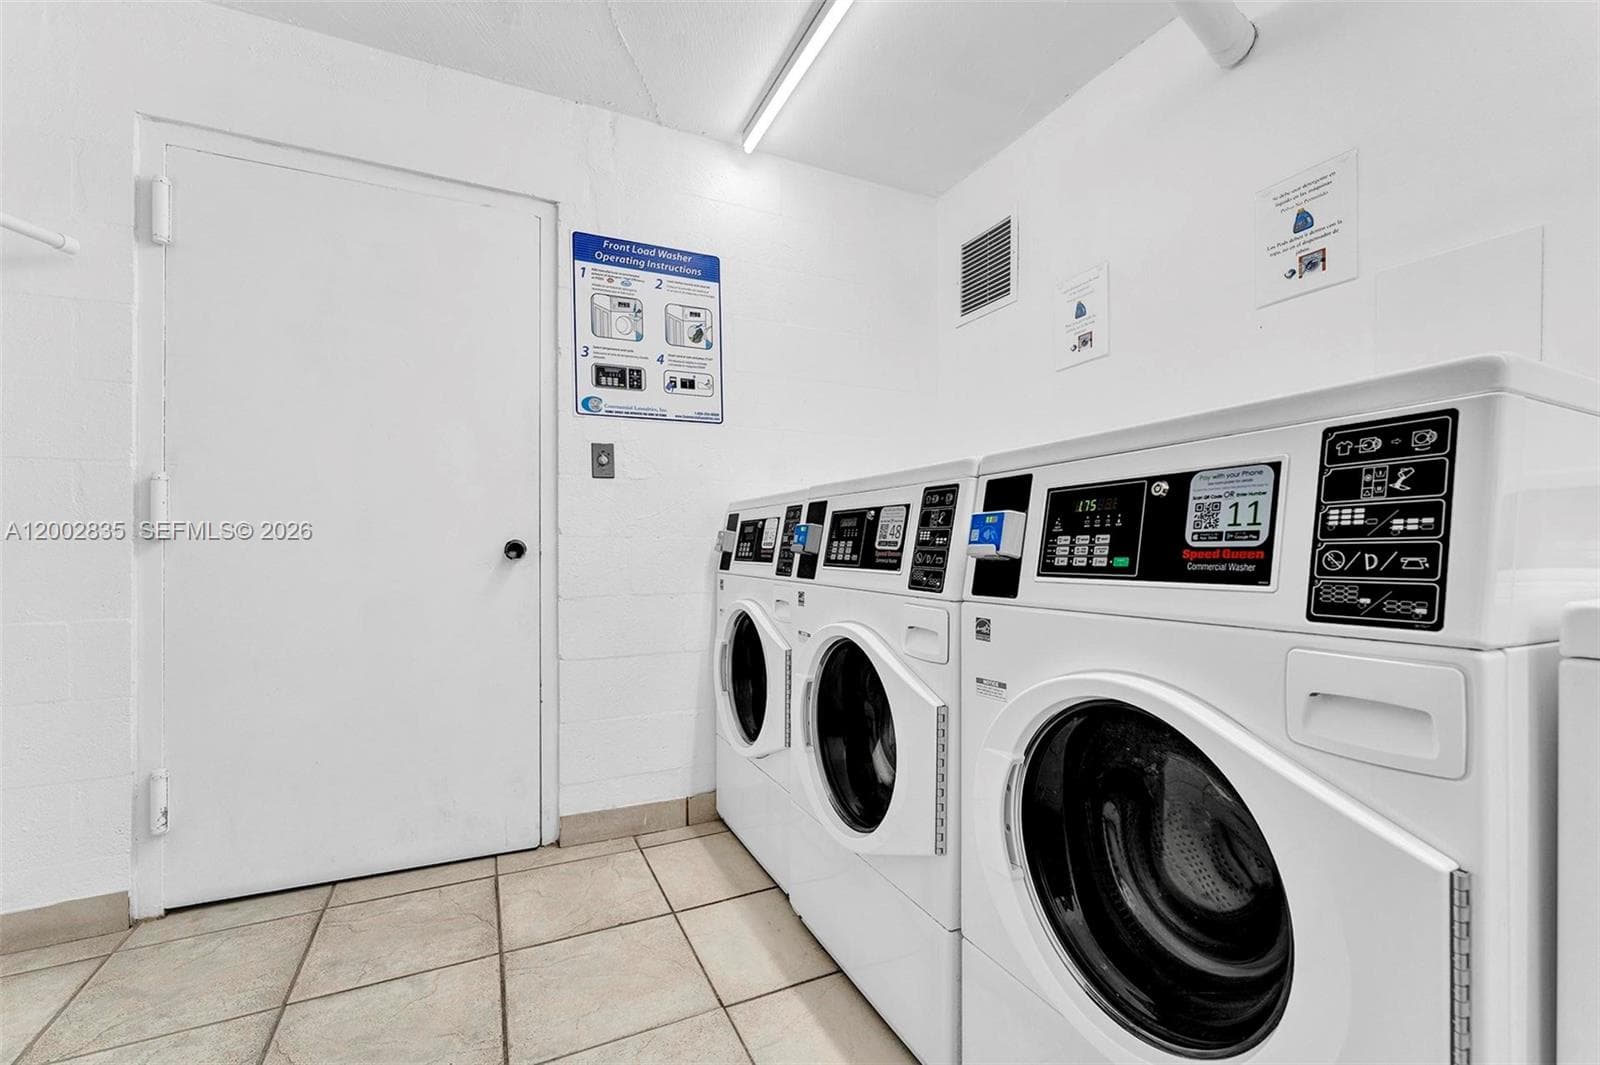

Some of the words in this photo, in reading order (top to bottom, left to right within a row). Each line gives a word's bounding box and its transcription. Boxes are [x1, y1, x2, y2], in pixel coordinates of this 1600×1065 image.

[603, 240, 630, 252] Front
[632, 245, 656, 256] Load
[658, 250, 692, 262] Washer
[594, 251, 645, 268] Operating
[647, 260, 702, 276] Instructions
[580, 267, 586, 278] 1
[655, 279, 663, 290] 2
[581, 346, 589, 357] 3
[656, 354, 664, 364] 4
[1224, 490, 1235, 498] OR
[1227, 500, 1262, 526] 11
[889, 525, 902, 539] 48
[1183, 549, 1220, 560] Speed
[1222, 549, 1264, 559] Queen
[1187, 562, 1227, 571] Commercial
[1228, 563, 1256, 571] Washer
